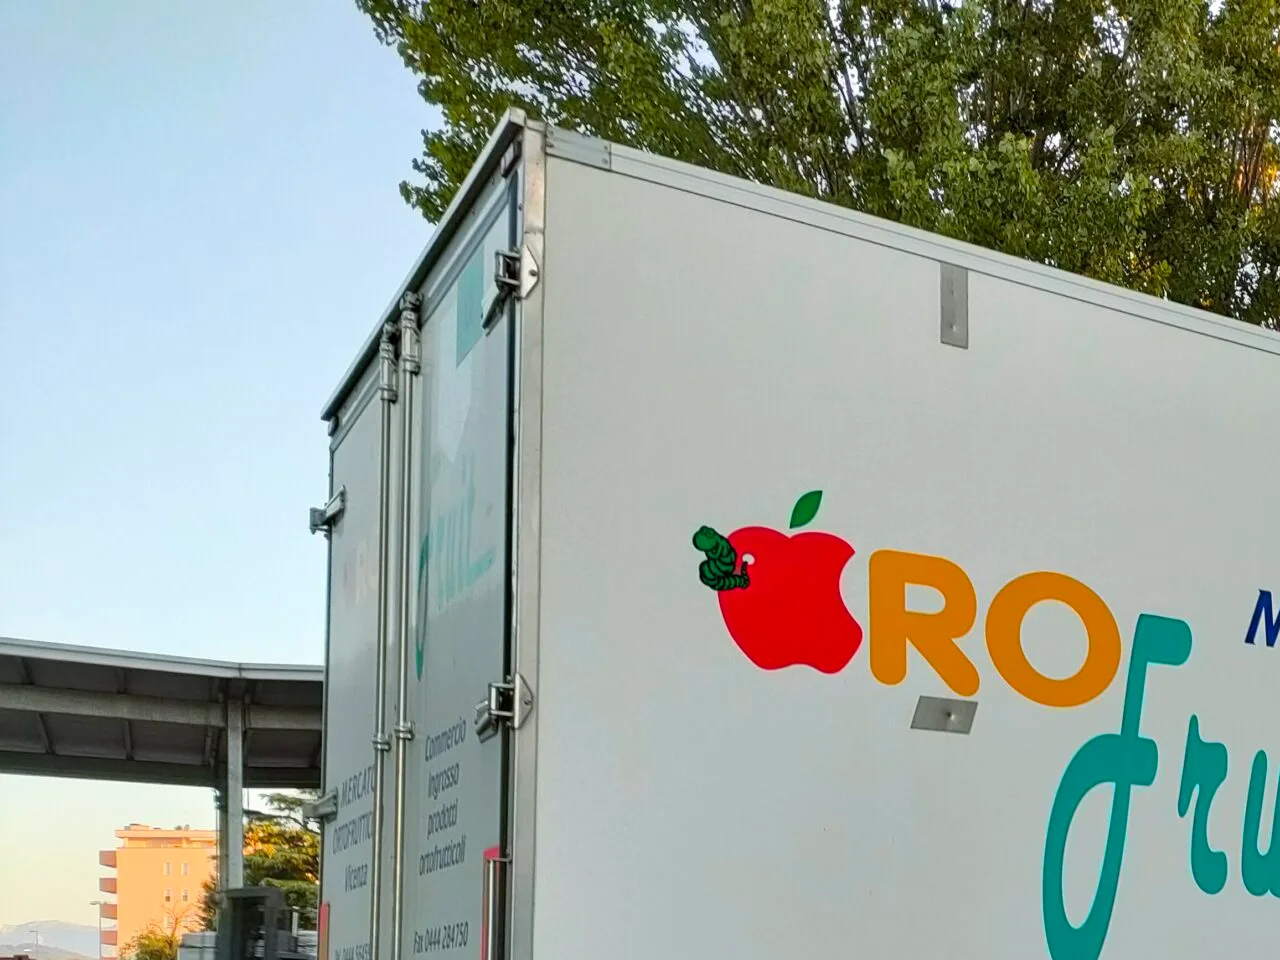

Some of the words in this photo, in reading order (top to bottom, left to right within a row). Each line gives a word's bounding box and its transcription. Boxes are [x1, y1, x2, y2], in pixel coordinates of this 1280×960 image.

[425, 715, 467, 762] Commercio
[426, 798, 459, 840] prodotti
[419, 834, 467, 876] ortofrutticoli
[413, 931, 424, 955] Fax
[424, 927, 441, 953] 0444
